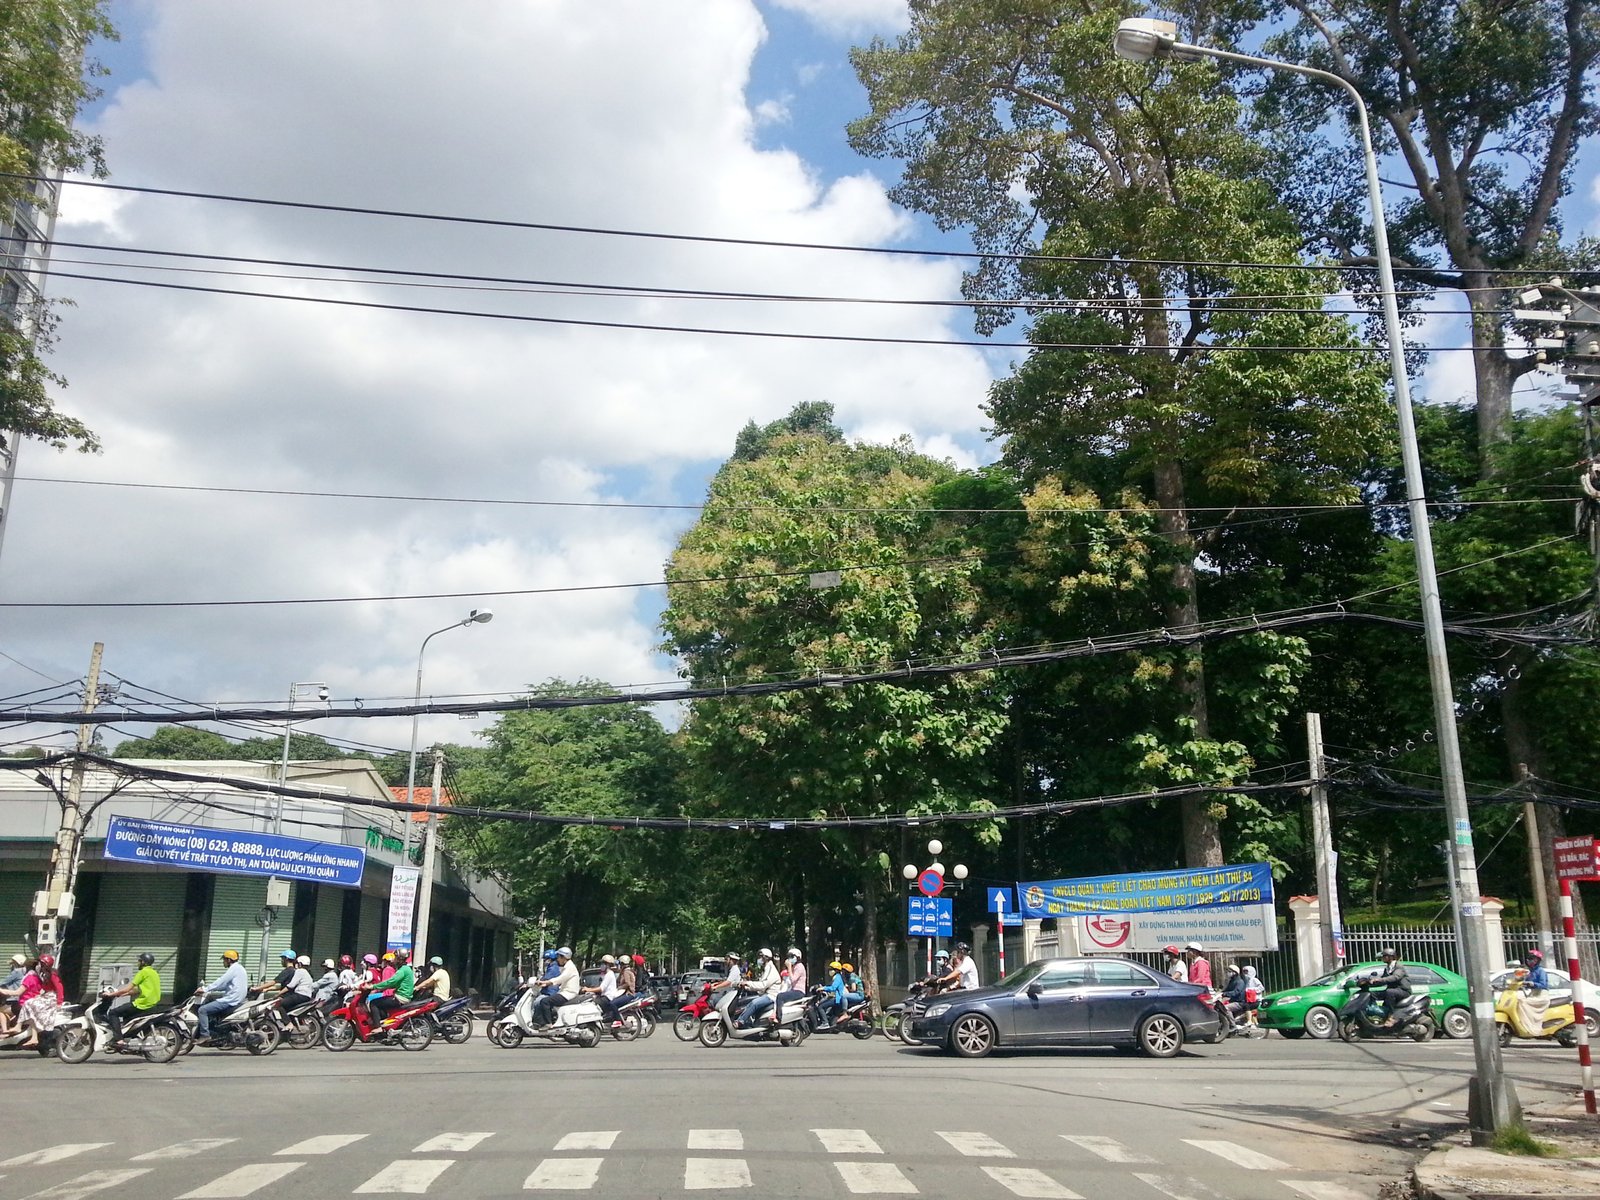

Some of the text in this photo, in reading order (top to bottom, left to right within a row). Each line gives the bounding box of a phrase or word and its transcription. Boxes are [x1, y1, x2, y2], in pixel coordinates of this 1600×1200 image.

[115, 830, 360, 869] ĐƯỜNG DÂY NÓNG (08) 629. 88888, LỰC LƯỢNG PHẢN ỨNG NHANH
[135, 845, 153, 857] GIẢI
[153, 847, 180, 860] QUYẾT
[180, 849, 190, 861] VỀ
[191, 851, 209, 865] TRẬT
[210, 853, 222, 866] TỰ
[221, 854, 233, 866] ĐÔ
[233, 857, 247, 870] THỊ,
[248, 860, 260, 869] AN
[260, 859, 280, 871] TOÀN
[281, 862, 291, 872] DU
[291, 865, 306, 875] LỊCH
[306, 866, 316, 877] TẠI
[316, 867, 335, 879] QUẬN
[1243, 870, 1253, 883] 84
[1156, 894, 1172, 907] NAM
[1218, 919, 1235, 928] MINH
